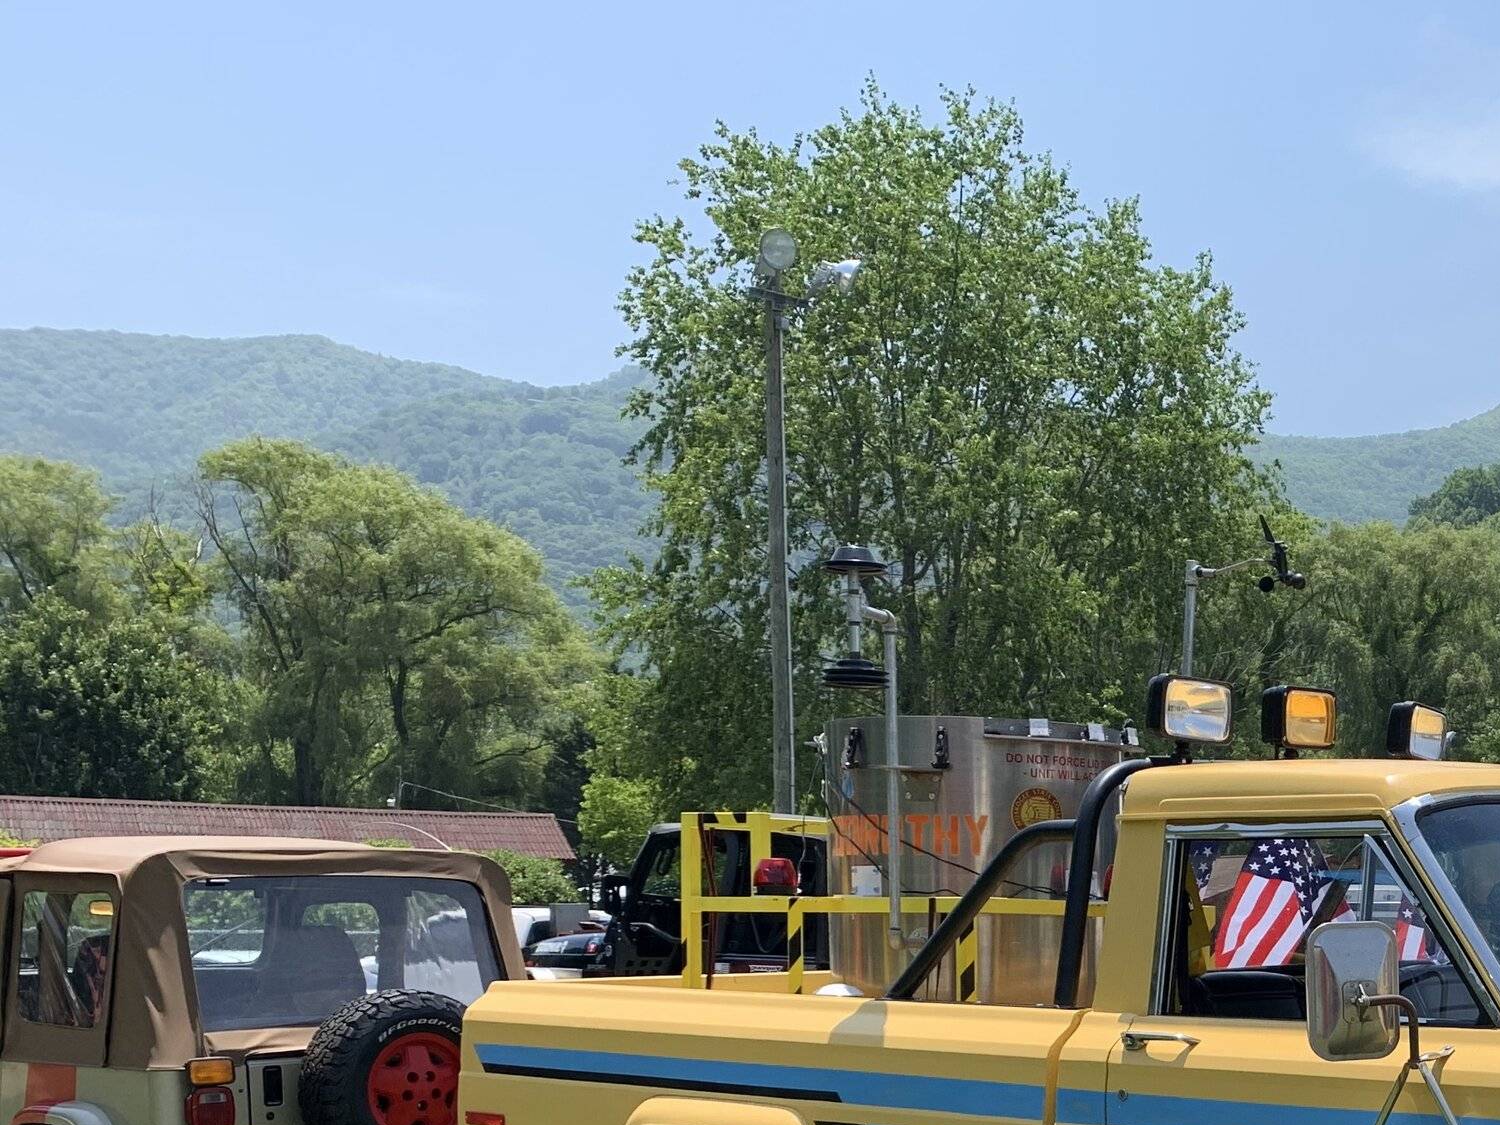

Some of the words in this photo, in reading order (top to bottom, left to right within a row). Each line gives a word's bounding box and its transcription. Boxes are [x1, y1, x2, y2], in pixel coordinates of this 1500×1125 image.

[1006, 752, 1023, 763] DO
[1027, 754, 1049, 765] NOT
[1053, 756, 1085, 768] FORCE
[1031, 768, 1055, 778] UNIT
[1057, 769, 1080, 780] WILL
[378, 1017, 461, 1043] BFGoodric
